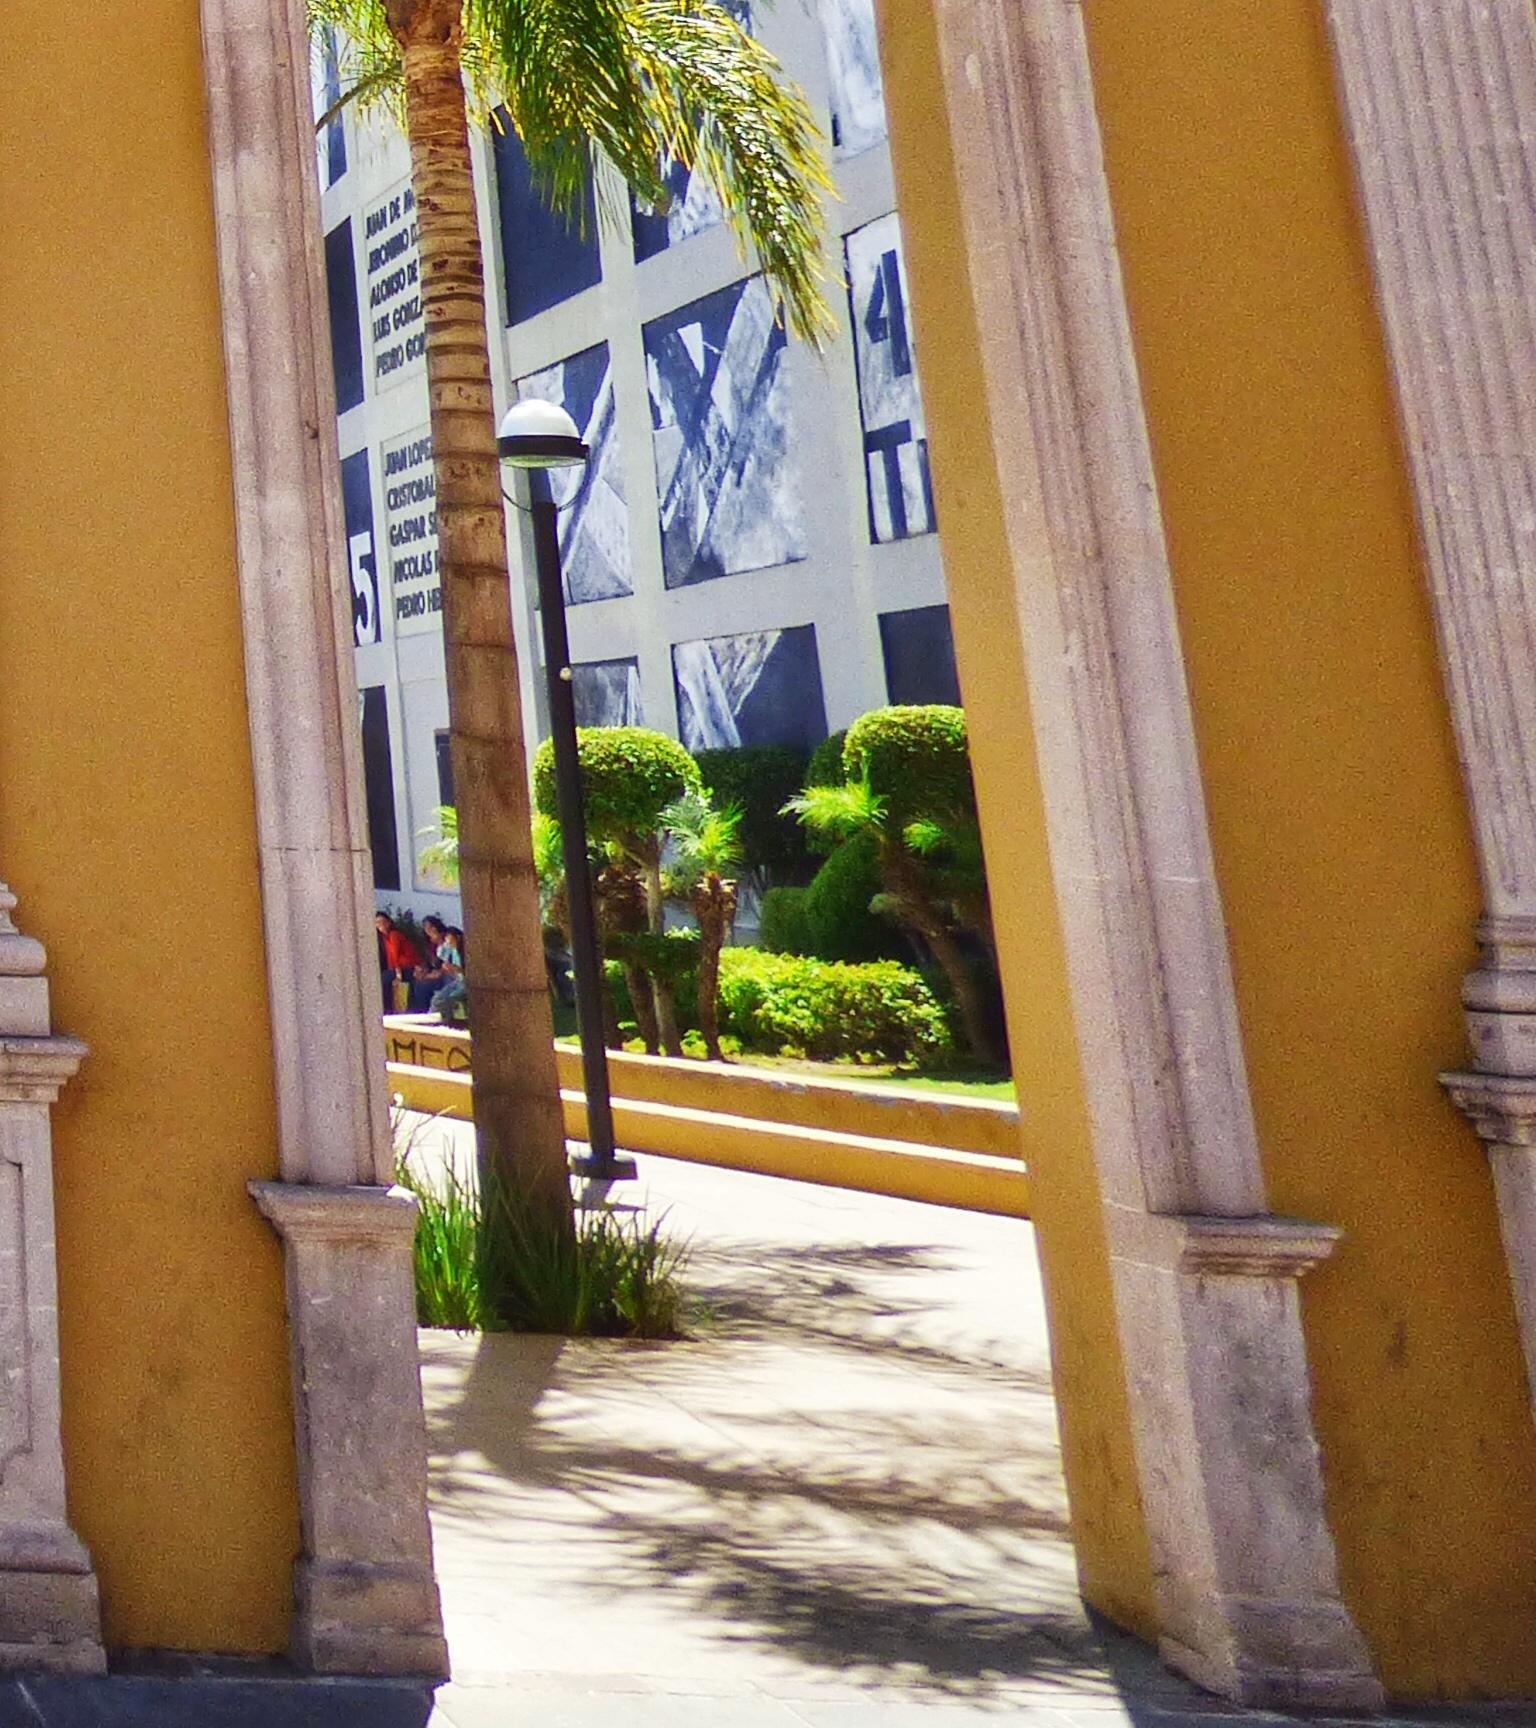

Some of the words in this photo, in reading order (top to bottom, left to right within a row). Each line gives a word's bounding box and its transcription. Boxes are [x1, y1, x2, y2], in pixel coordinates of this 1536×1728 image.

[366, 206, 387, 239] JUAN
[389, 196, 401, 224] DE
[370, 267, 406, 309] ALONSO
[407, 259, 418, 286] DE
[373, 312, 391, 343] LUIS
[864, 248, 911, 378] 4
[375, 345, 404, 378] PEDRO
[385, 447, 407, 476] JUAN
[390, 515, 426, 547] GASPAR
[394, 551, 432, 584] NICOLAS
[396, 590, 425, 620] PEDRO
